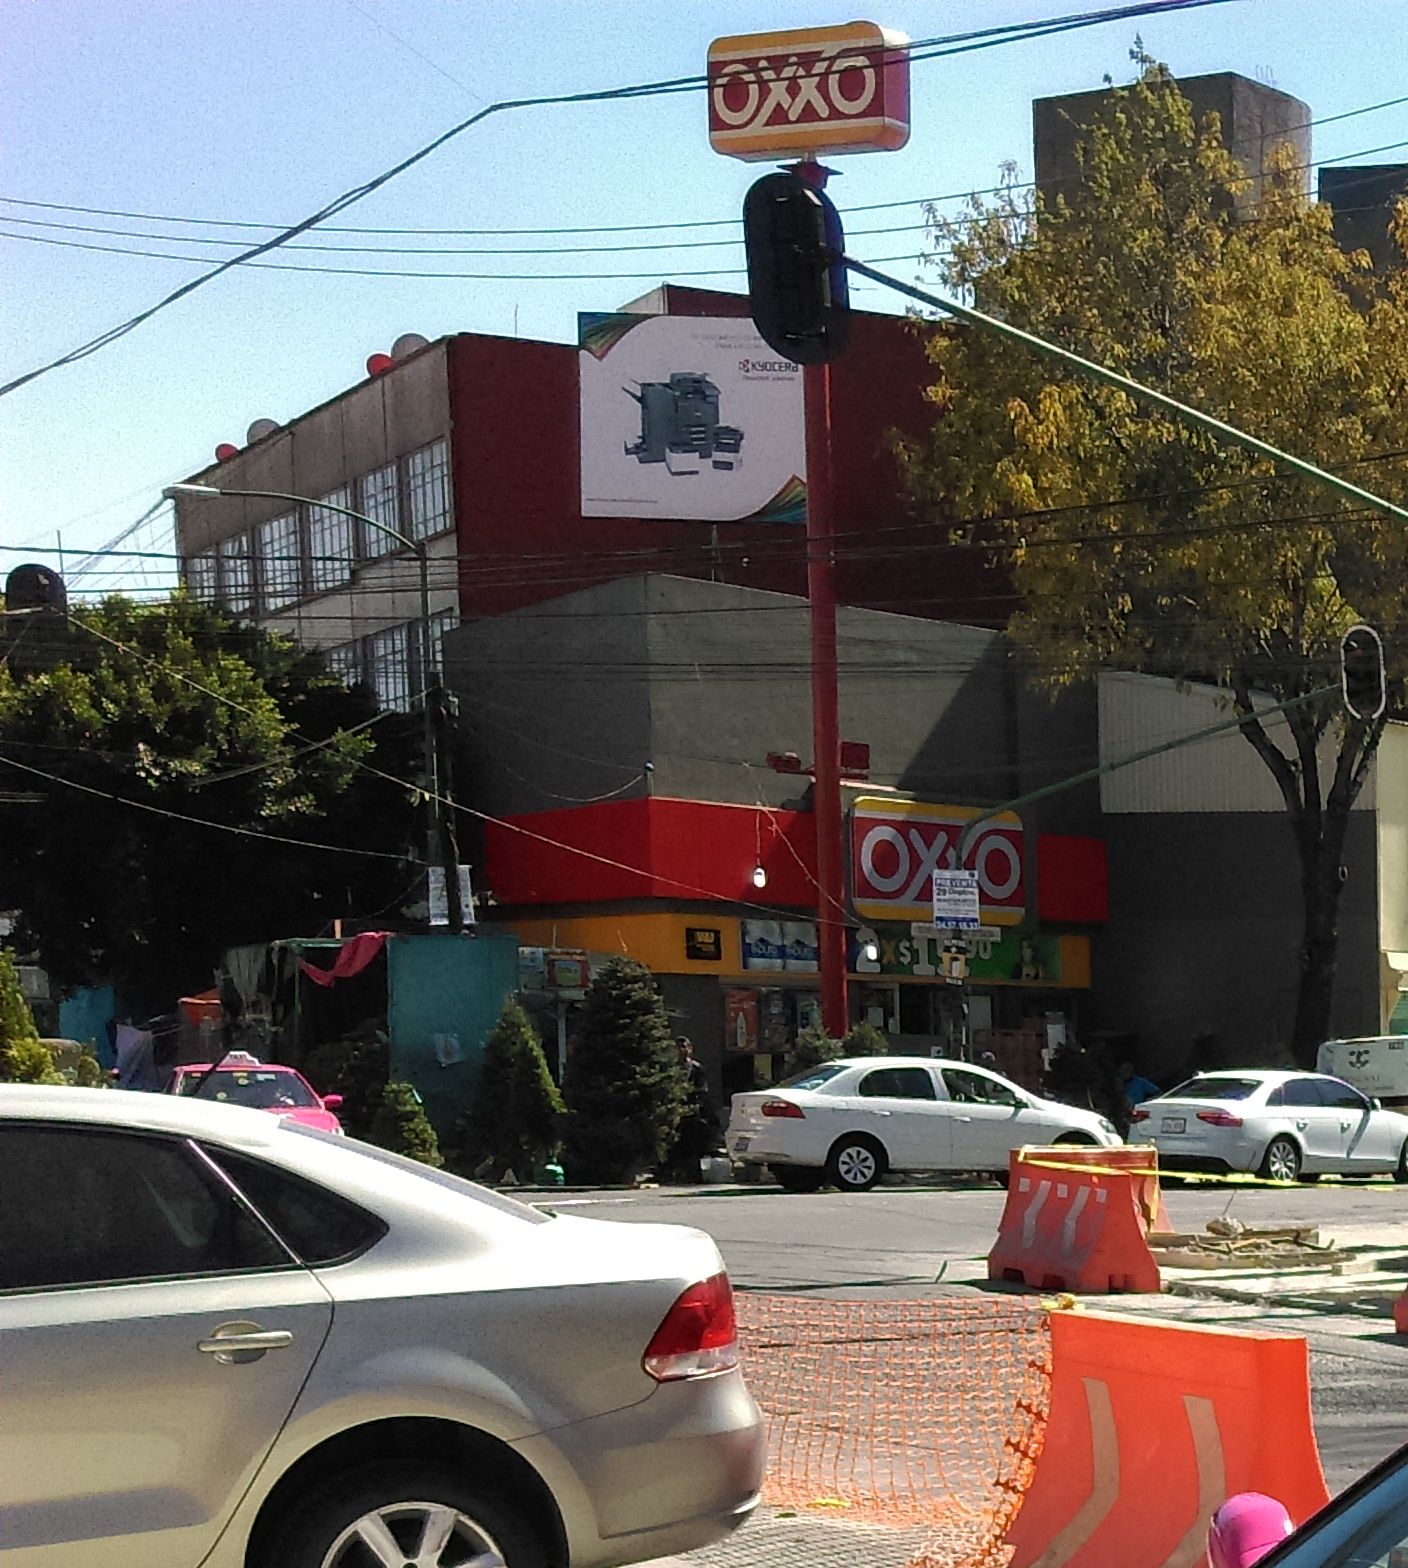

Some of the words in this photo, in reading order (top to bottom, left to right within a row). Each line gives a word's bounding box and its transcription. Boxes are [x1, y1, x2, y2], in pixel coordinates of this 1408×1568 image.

[713, 56, 876, 126] OXXO
[750, 360, 799, 373] KYOCERA
[861, 825, 1021, 900] OXO
